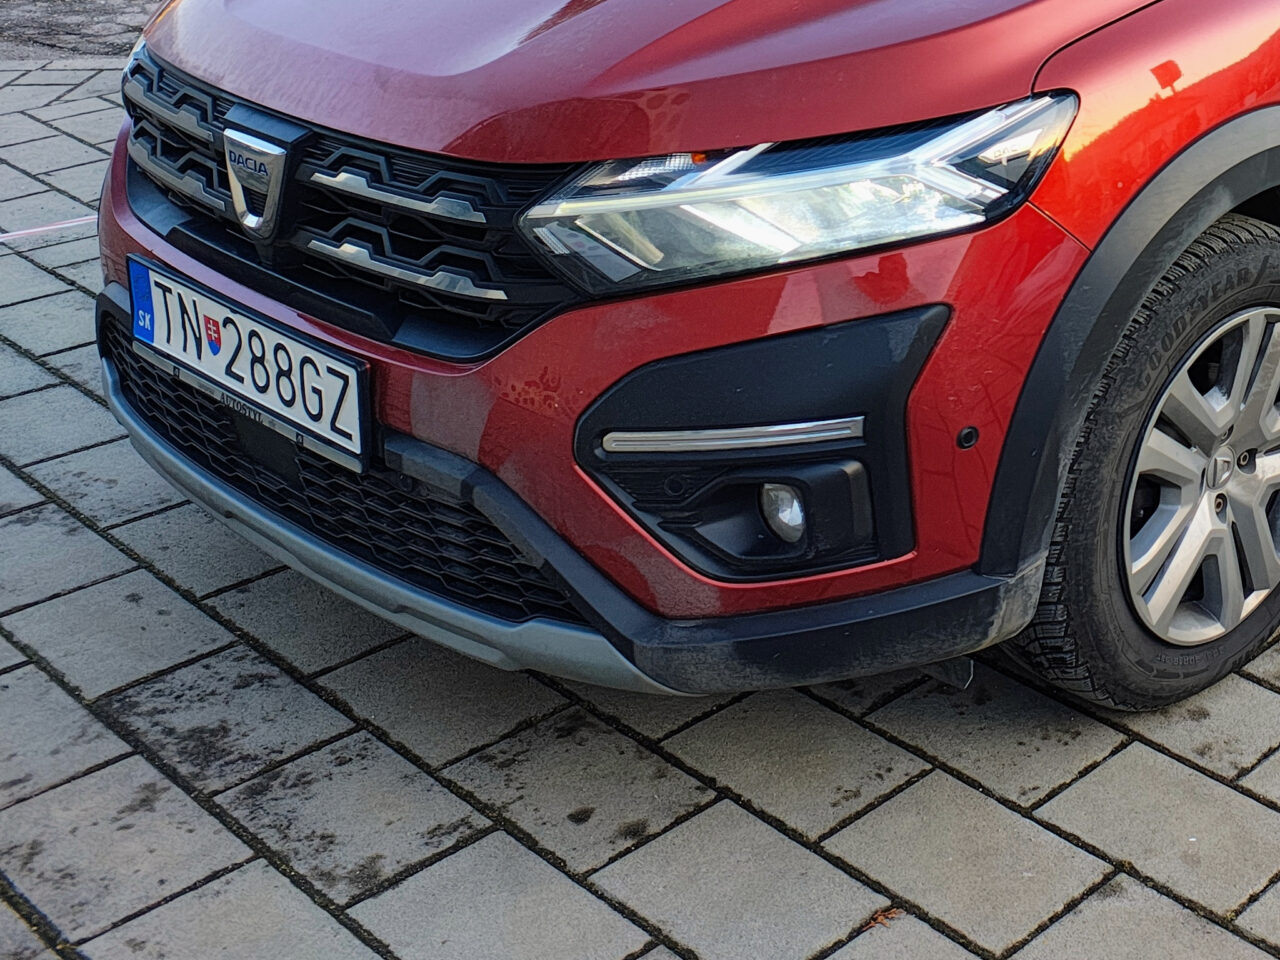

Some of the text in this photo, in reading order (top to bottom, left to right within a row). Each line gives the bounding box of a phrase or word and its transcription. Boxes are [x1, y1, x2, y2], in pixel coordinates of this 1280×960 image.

[228, 150, 268, 176] DACIA
[137, 309, 152, 331] SK
[154, 280, 353, 442] TN 288GZ
